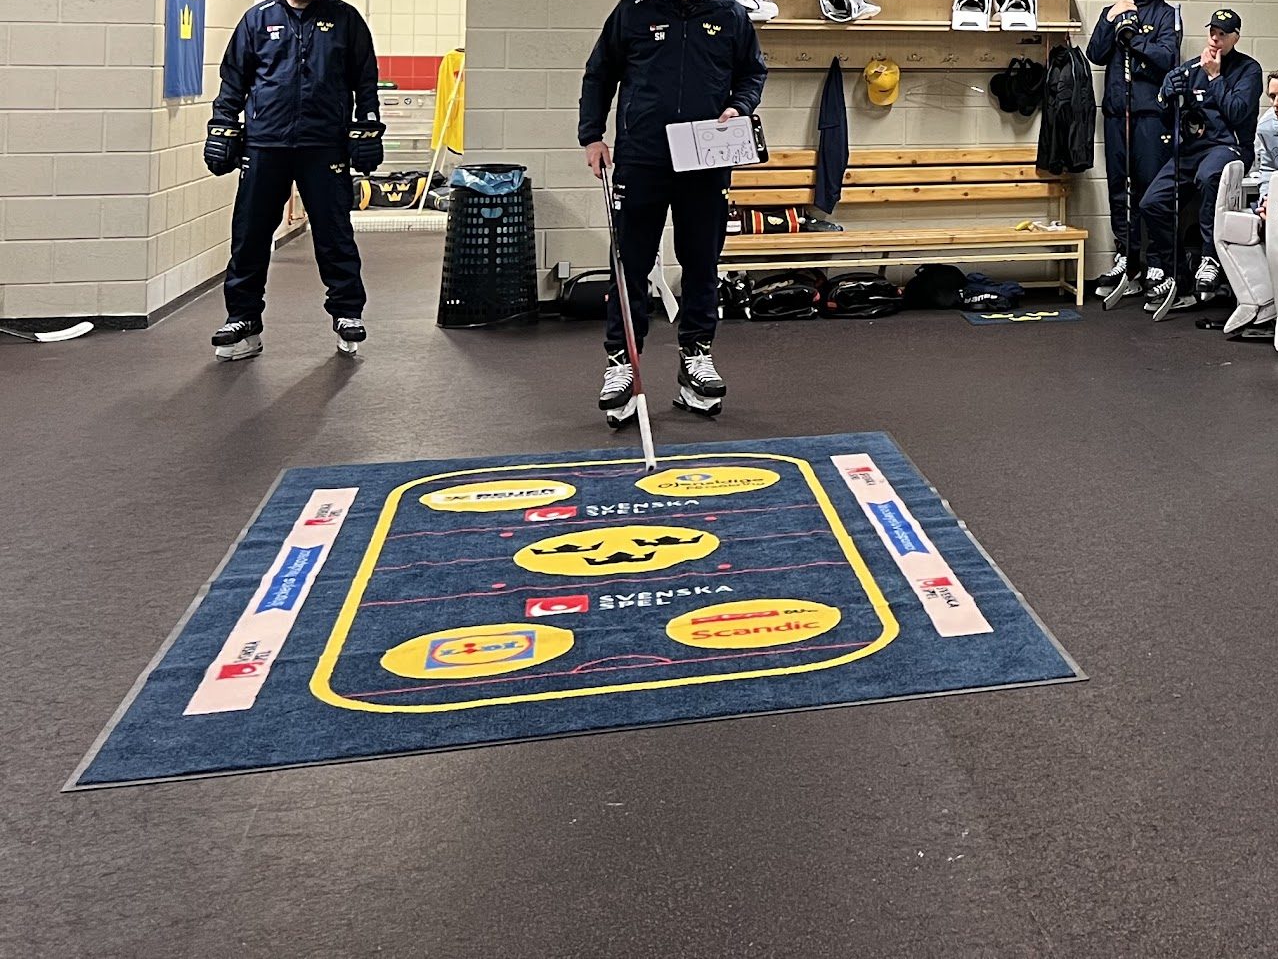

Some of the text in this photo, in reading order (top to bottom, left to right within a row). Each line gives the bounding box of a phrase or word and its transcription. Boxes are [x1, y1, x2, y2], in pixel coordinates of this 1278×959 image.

[210, 128, 240, 137] CC
[348, 130, 379, 139] CM
[599, 586, 734, 601] SVENSKA
[691, 621, 821, 640] Scandic
